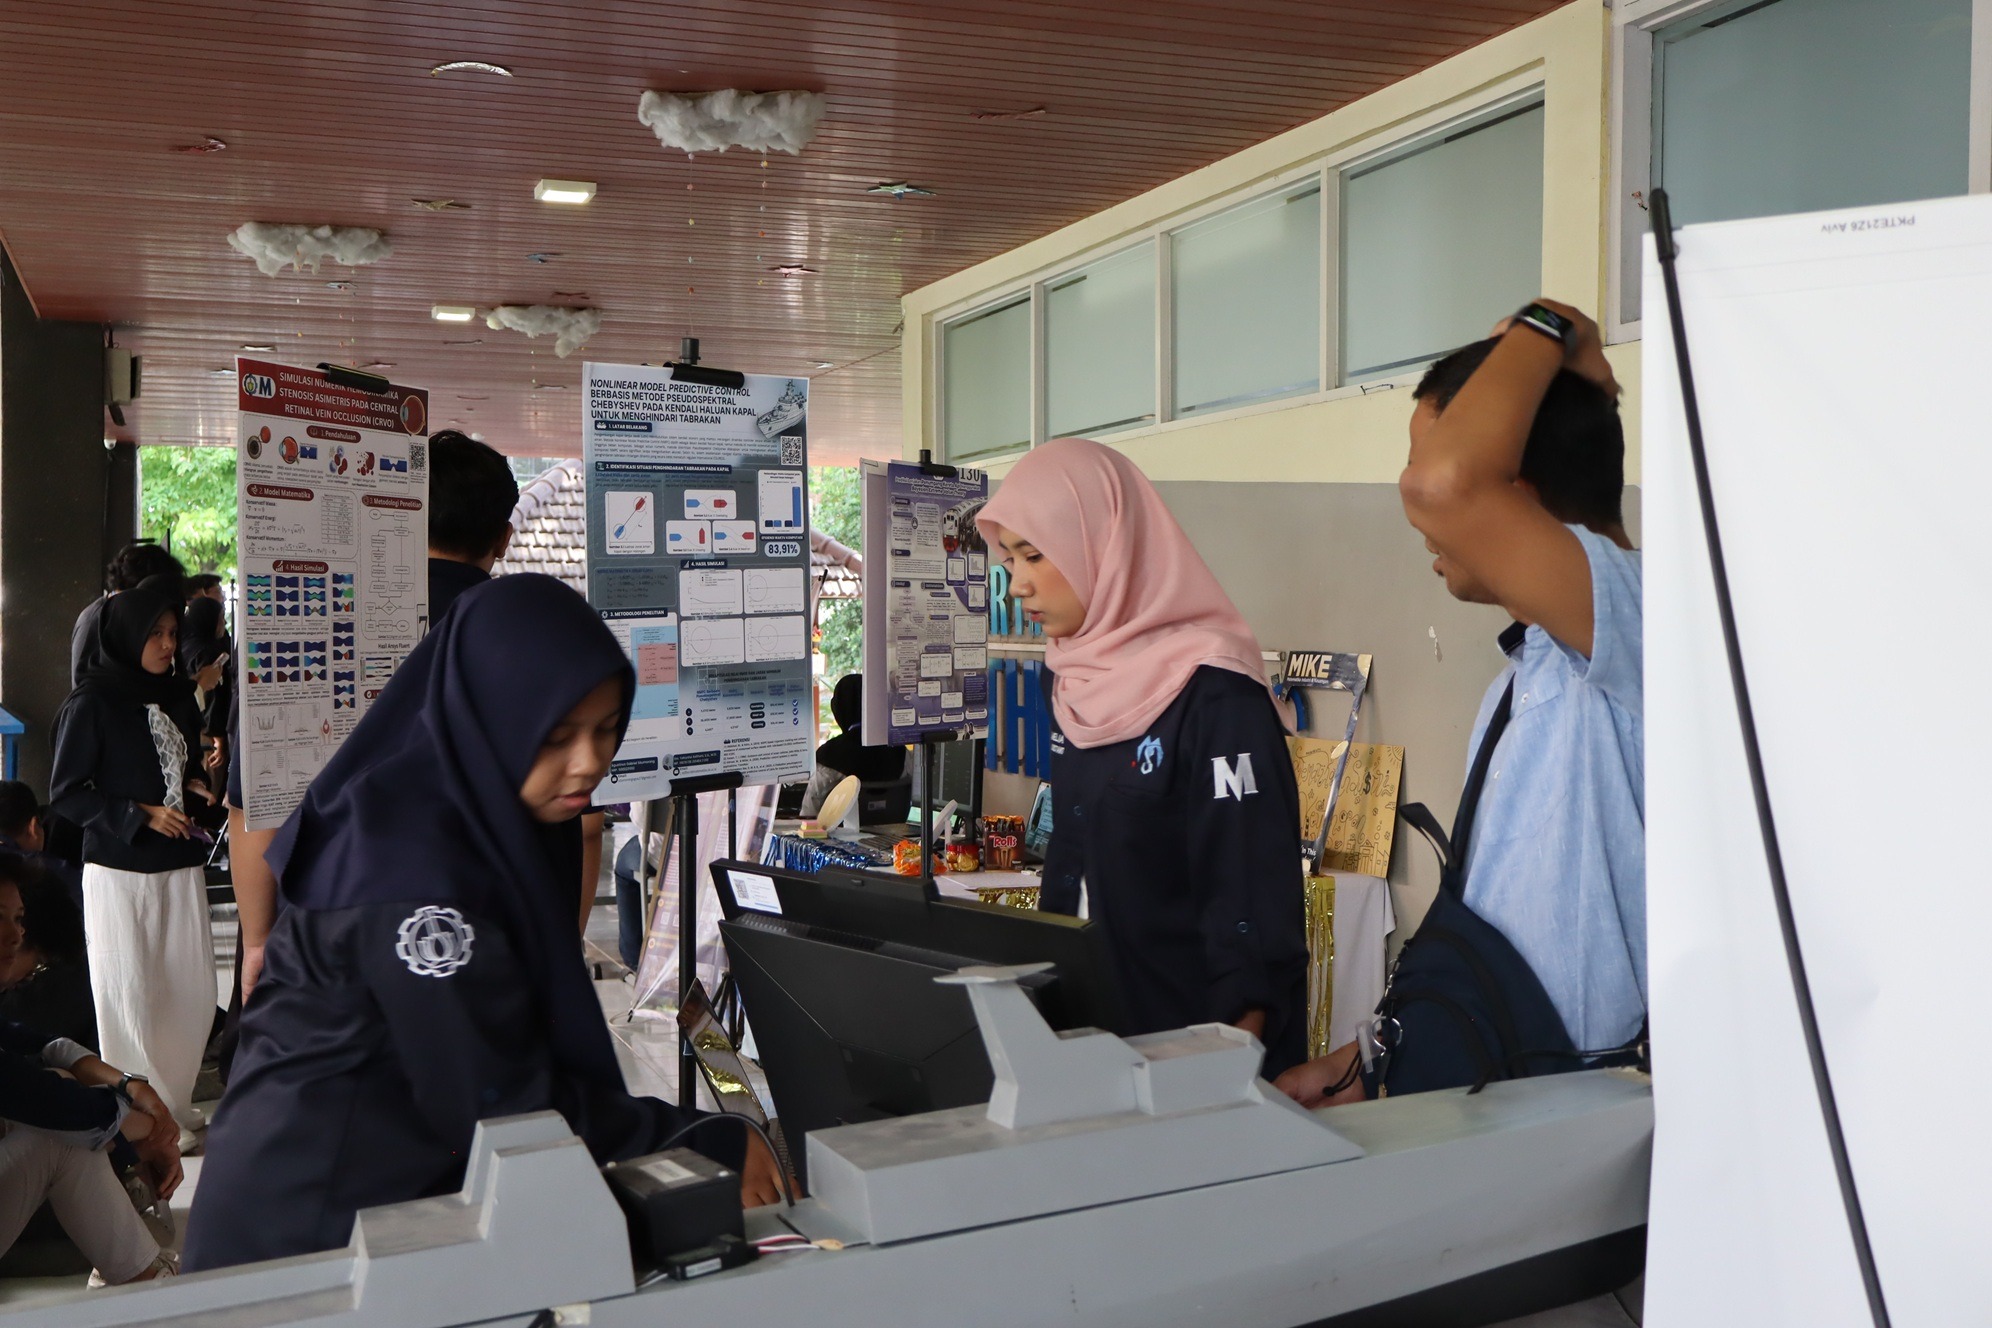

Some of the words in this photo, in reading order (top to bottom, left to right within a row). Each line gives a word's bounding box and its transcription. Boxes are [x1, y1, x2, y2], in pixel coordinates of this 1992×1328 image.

[1821, 223, 1846, 233] Aviv
[280, 372, 314, 385] SIMULASI
[591, 379, 637, 390] NONLINEAR
[640, 382, 667, 391] MODEL
[669, 384, 713, 394] PREDICTIVE
[715, 387, 750, 396] CONTROL
[280, 388, 314, 400] STENOSIS
[315, 395, 351, 406] ASIMETRIS
[352, 400, 368, 409] PADA
[370, 404, 398, 414] CENTRAL
[591, 390, 630, 399] BERBASIS
[632, 392, 665, 401] METODE
[666, 395, 736, 405] PSEUDOSPEKTRAL
[591, 400, 640, 410] CHEBYSHEV
[665, 404, 697, 413] KENDALI
[701, 406, 730, 414] HALUAN
[733, 408, 756, 416] KAPAL
[285, 405, 313, 416] RETINAL
[316, 409, 331, 418] VEIN
[333, 412, 371, 424] OCCLUSION
[372, 417, 394, 428] (CRVO)
[622, 412, 677, 422] MENGHINDARI
[680, 415, 720, 424] TABRAKAN
[282, 490, 310, 498] Matematika
[374, 499, 399, 507] Metodologi
[768, 544, 798, 555] 83,91%
[1288, 654, 1332, 678] MIKE
[1211, 753, 1258, 801] M
[994, 836, 1017, 847] Rolls
[1307, 848, 1316, 856] This
